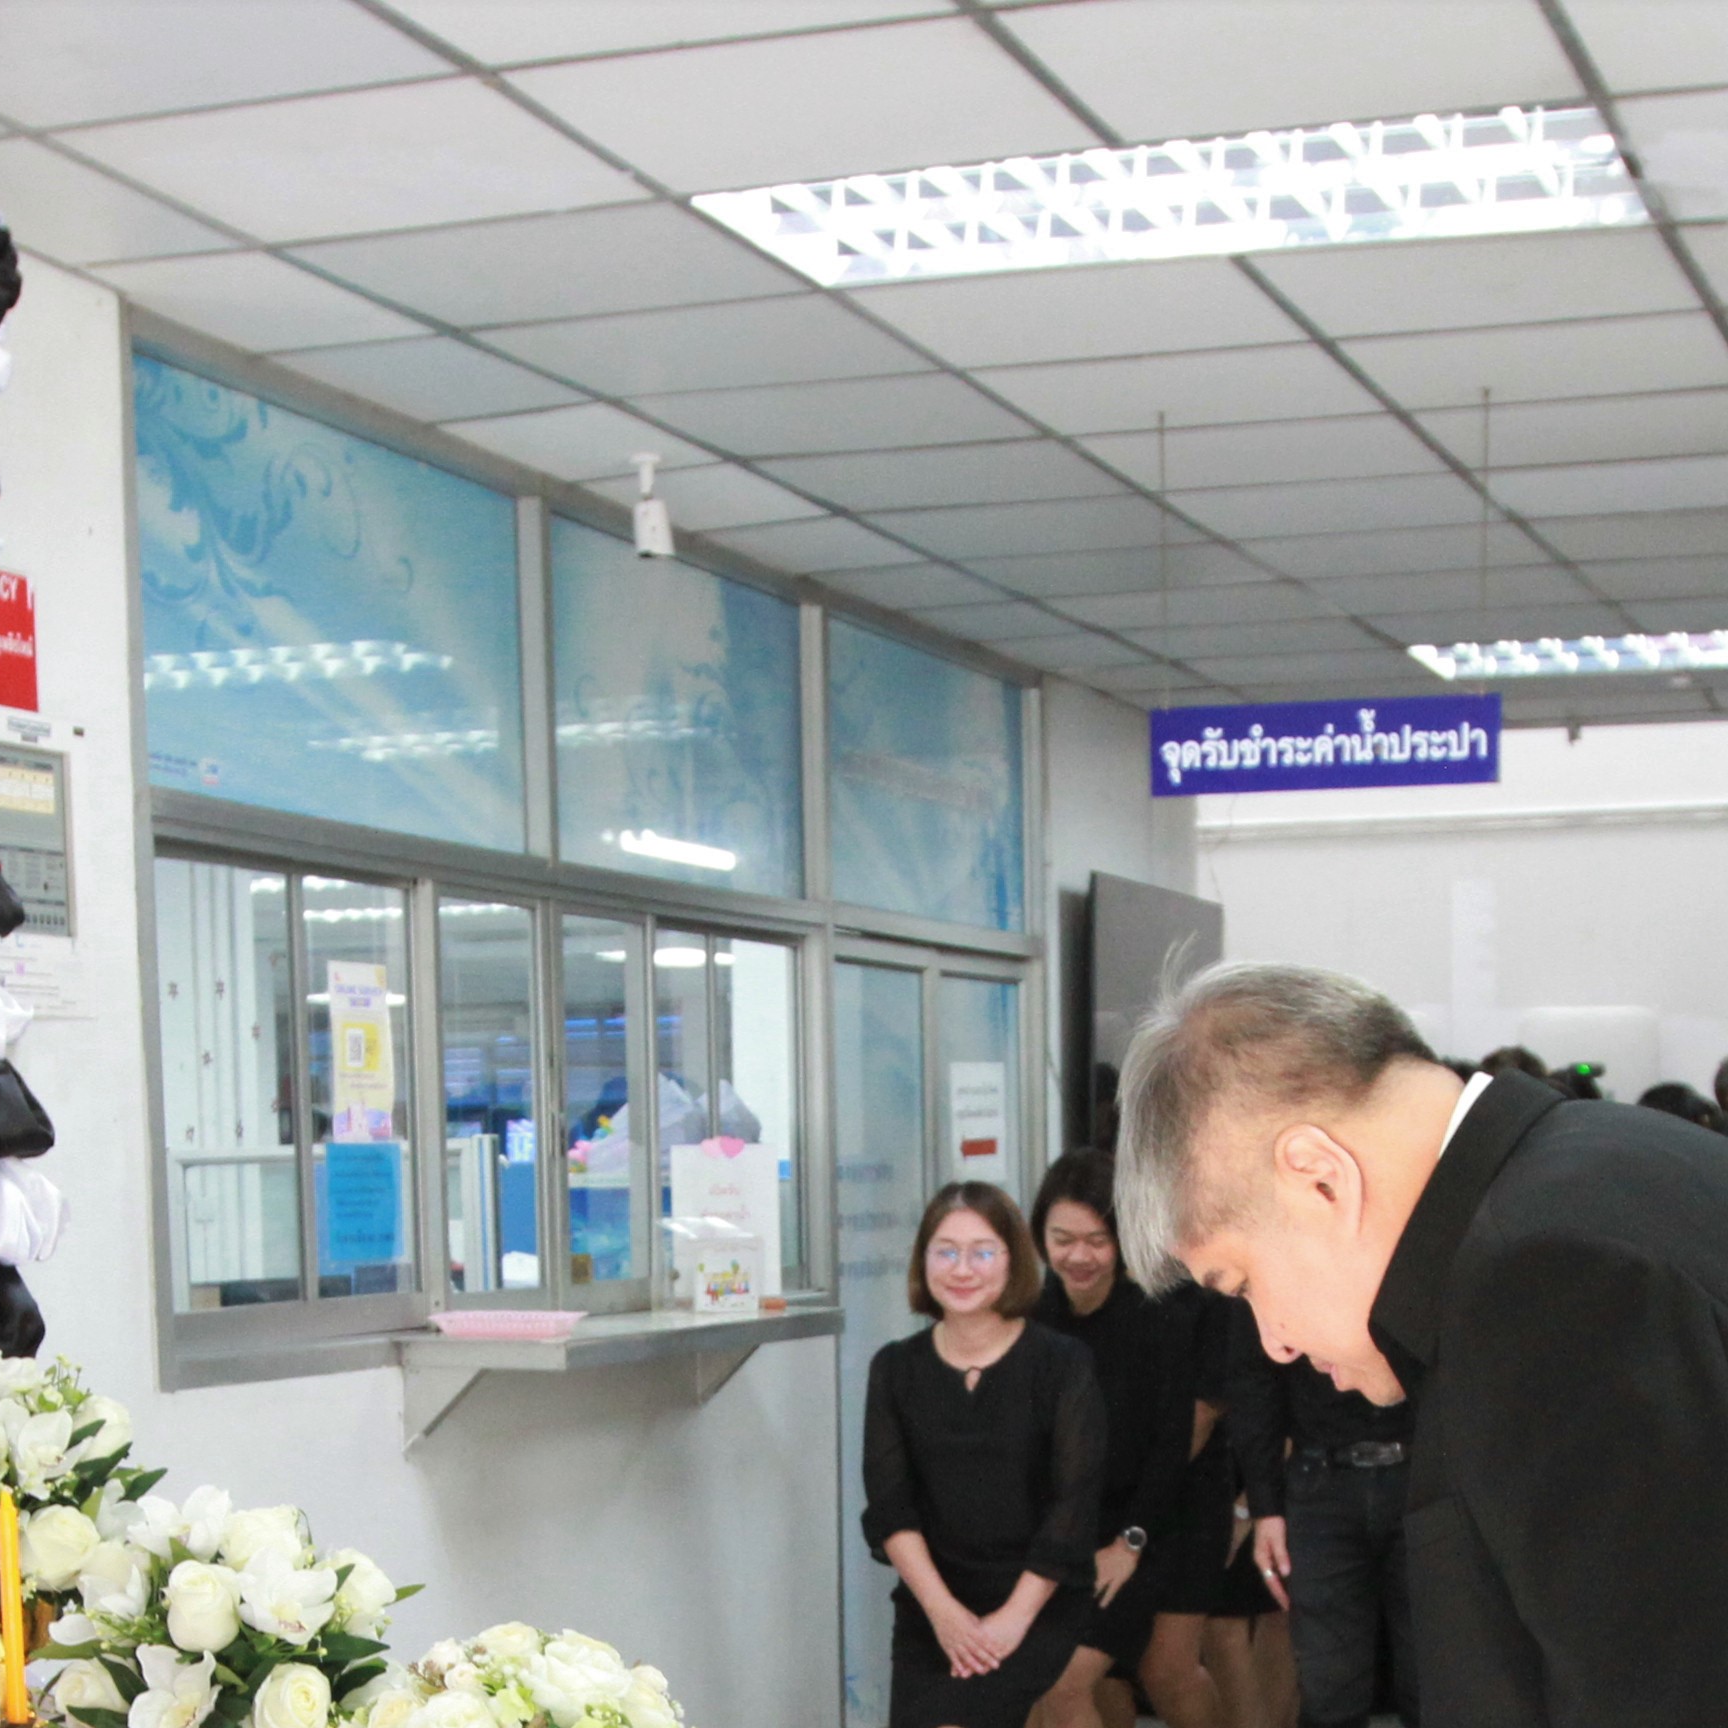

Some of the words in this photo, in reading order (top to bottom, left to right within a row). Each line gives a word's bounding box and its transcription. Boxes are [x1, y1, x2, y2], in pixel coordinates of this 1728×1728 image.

[1161, 708, 1488, 785] จุดรับชำระค่าน้ำประปา
